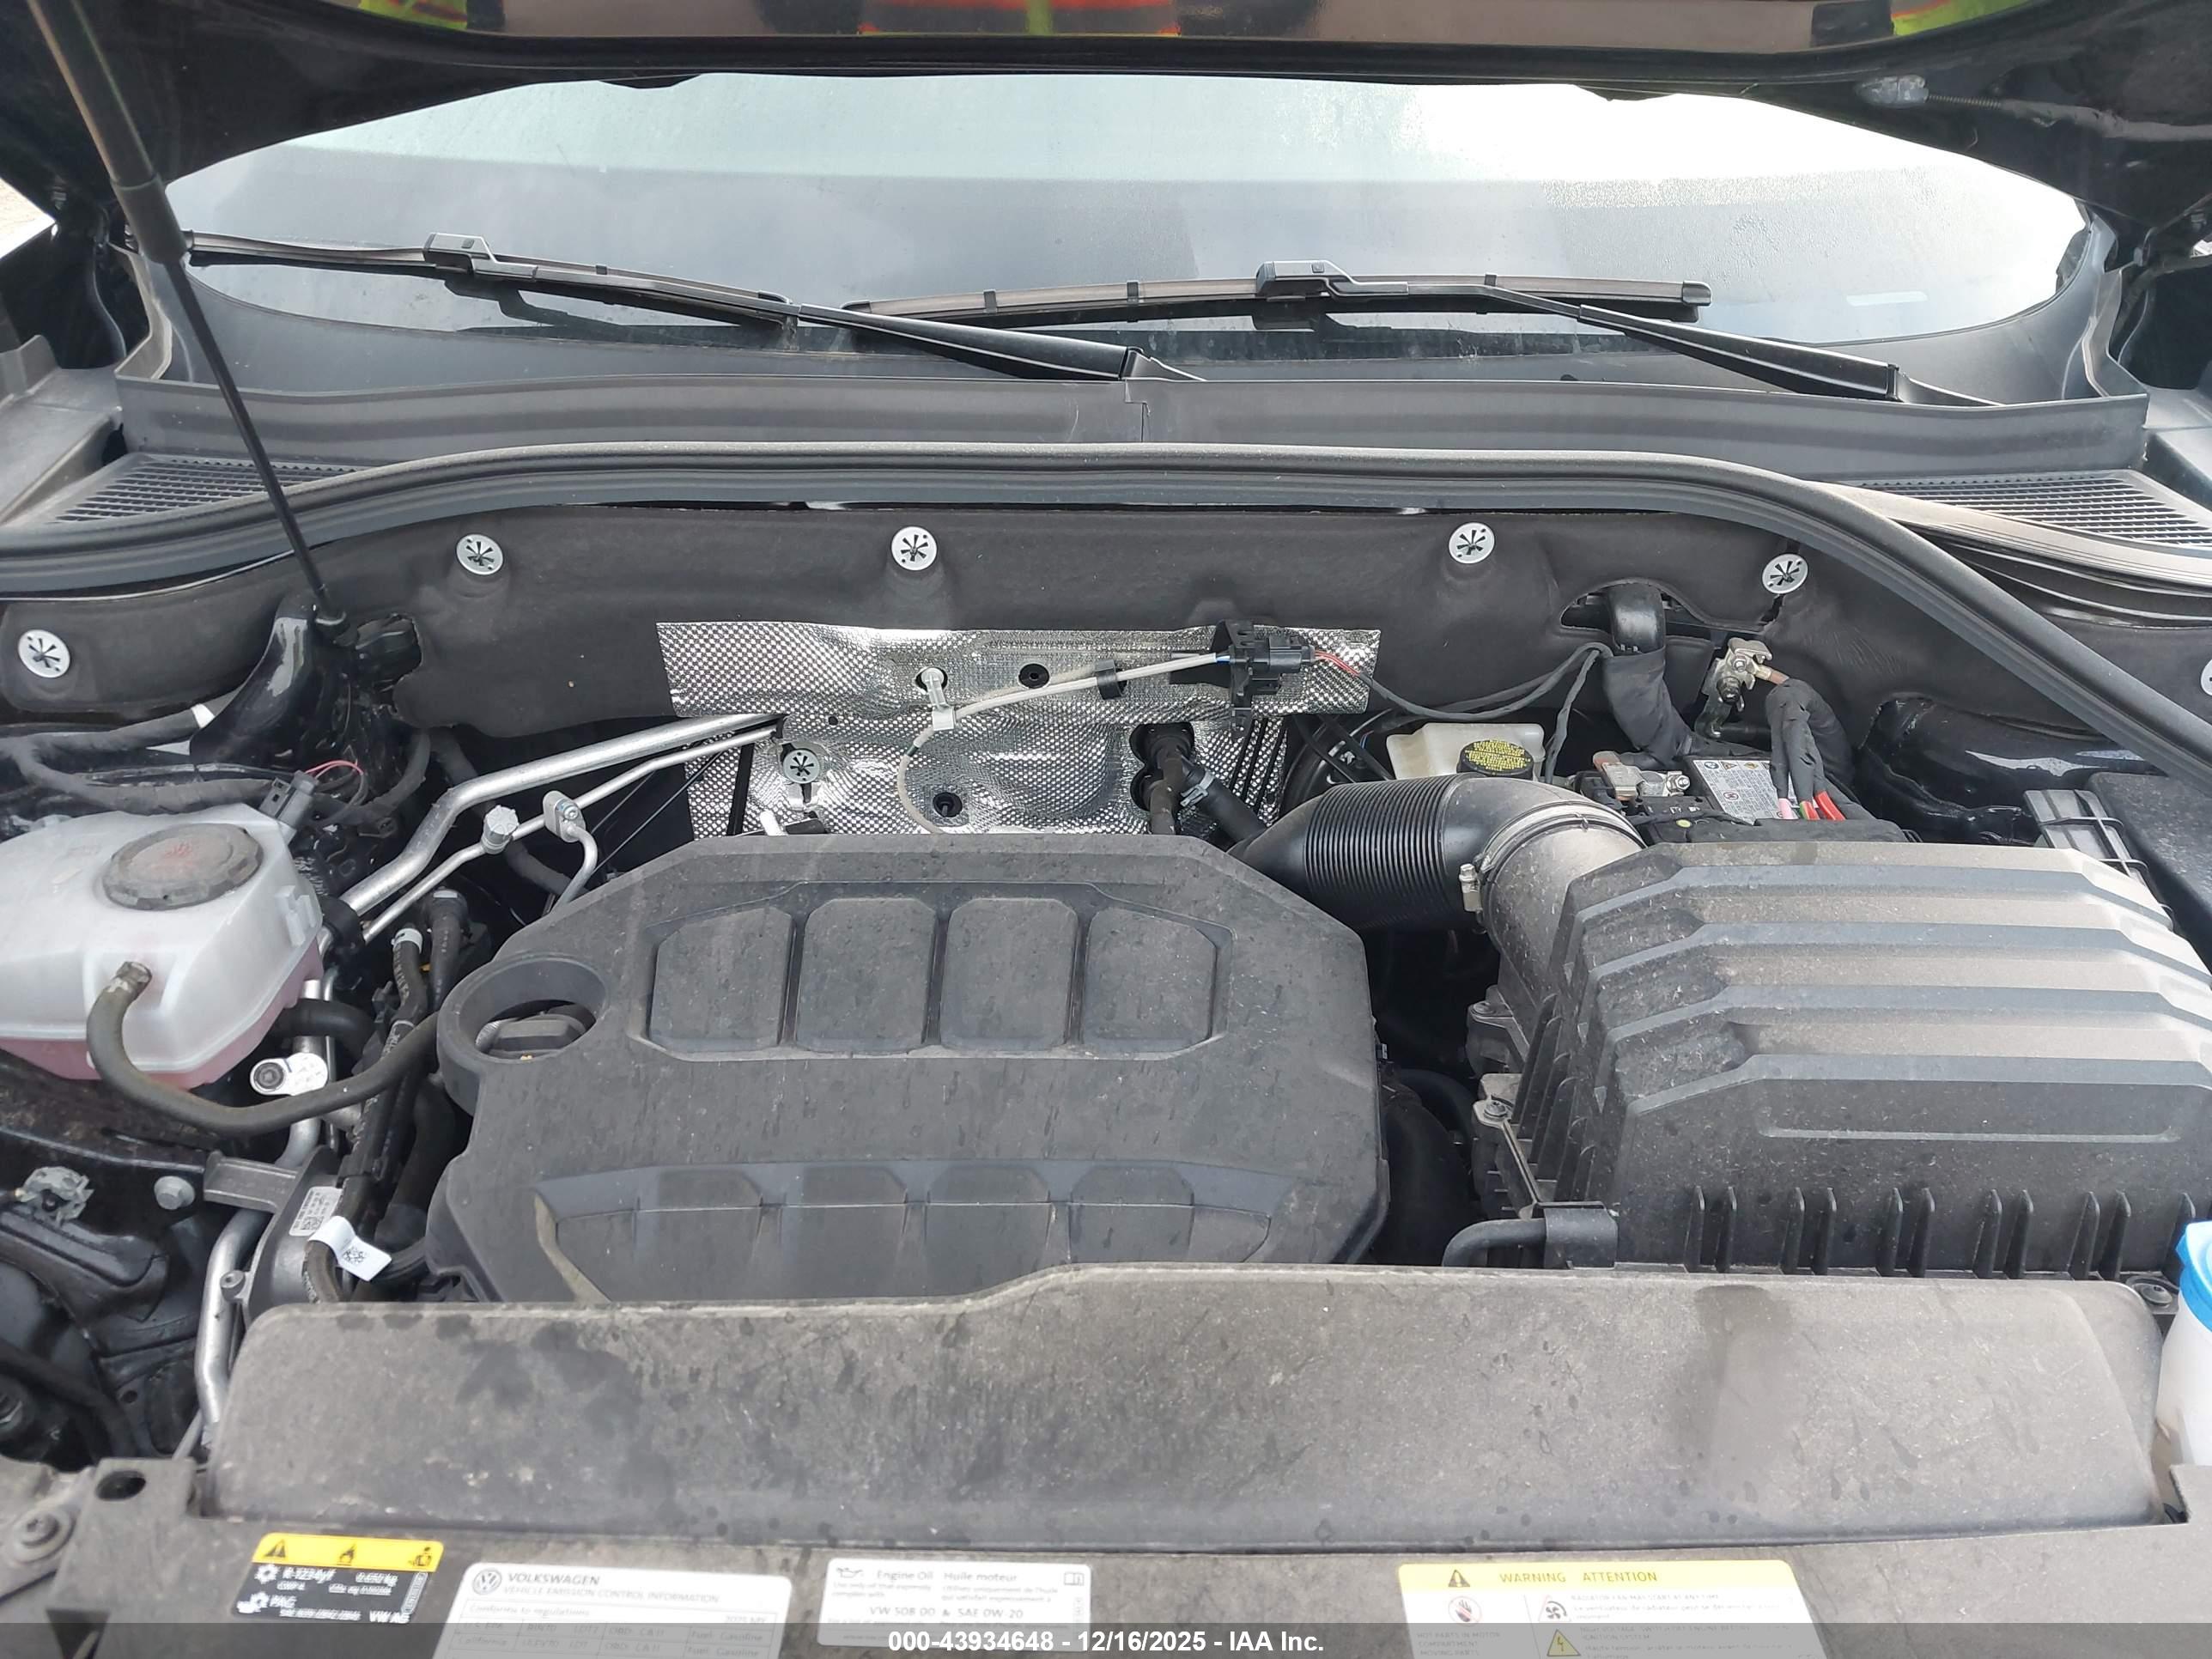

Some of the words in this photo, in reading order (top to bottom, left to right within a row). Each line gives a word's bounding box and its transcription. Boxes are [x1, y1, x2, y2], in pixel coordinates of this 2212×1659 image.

[507, 1572, 600, 1585] VOLKSWAGEN
[877, 1570, 915, 1582] Engine
[917, 1571, 933, 1580] Oil
[944, 1571, 973, 1582] Huile
[975, 1572, 1018, 1582] moteur
[1499, 1572, 1566, 1583] WARNING
[1583, 1571, 1657, 1583] ATTENTION
[598, 1589, 644, 1600] CONTROL
[647, 1591, 720, 1603] INFORMATION
[369, 1611, 391, 1623] VW
[870, 1607, 891, 1615] VW
[895, 1607, 916, 1616] 508
[920, 1607, 936, 1616] 00
[942, 1608, 951, 1617] &
[957, 1607, 979, 1617] SAE
